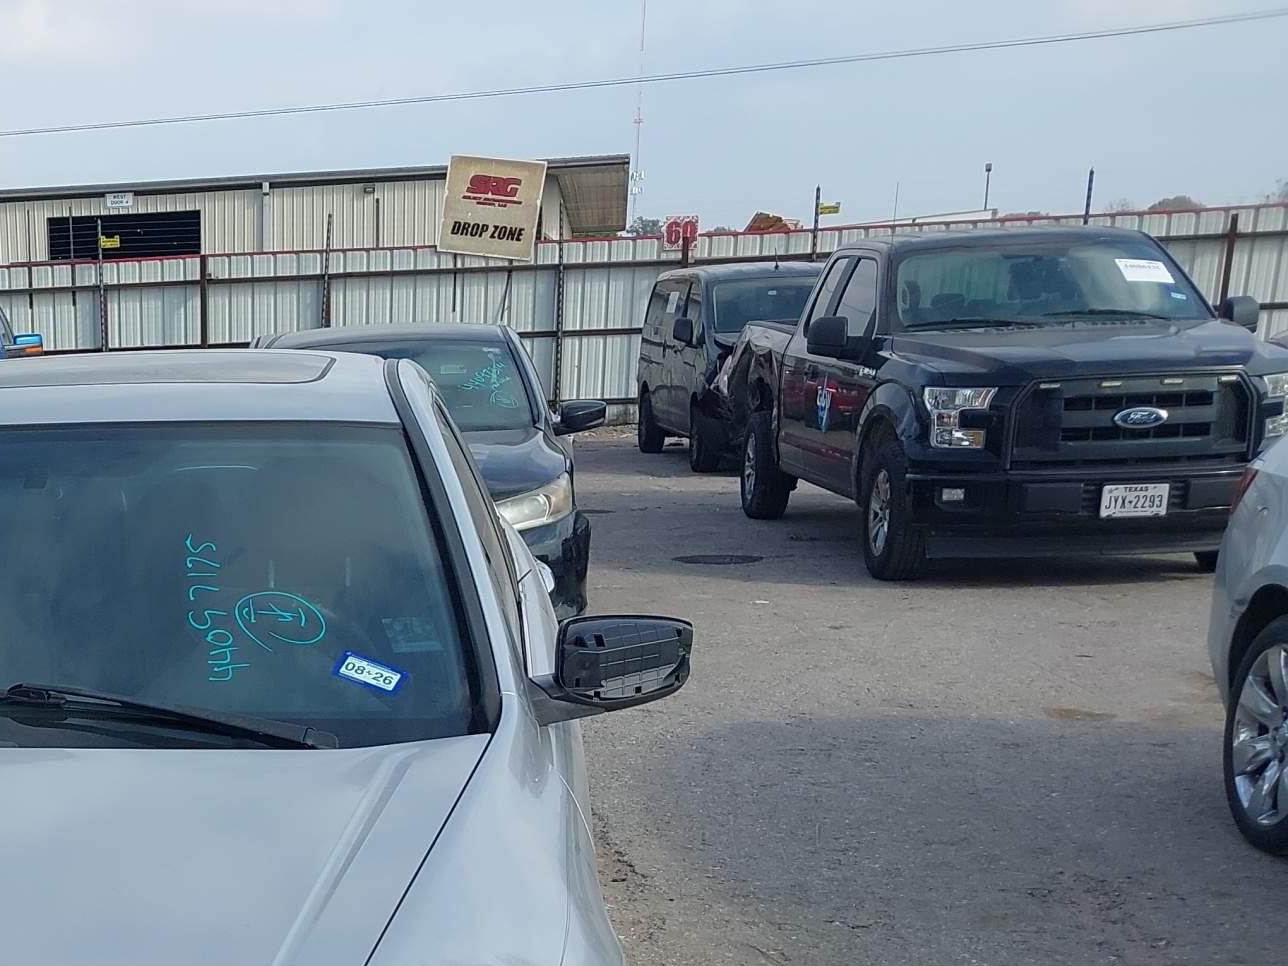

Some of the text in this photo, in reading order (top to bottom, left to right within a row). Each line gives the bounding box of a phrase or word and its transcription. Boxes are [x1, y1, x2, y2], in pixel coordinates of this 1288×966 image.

[465, 174, 523, 197] SRG
[451, 221, 525, 242] DROP ZONE
[665, 220, 697, 245] 60
